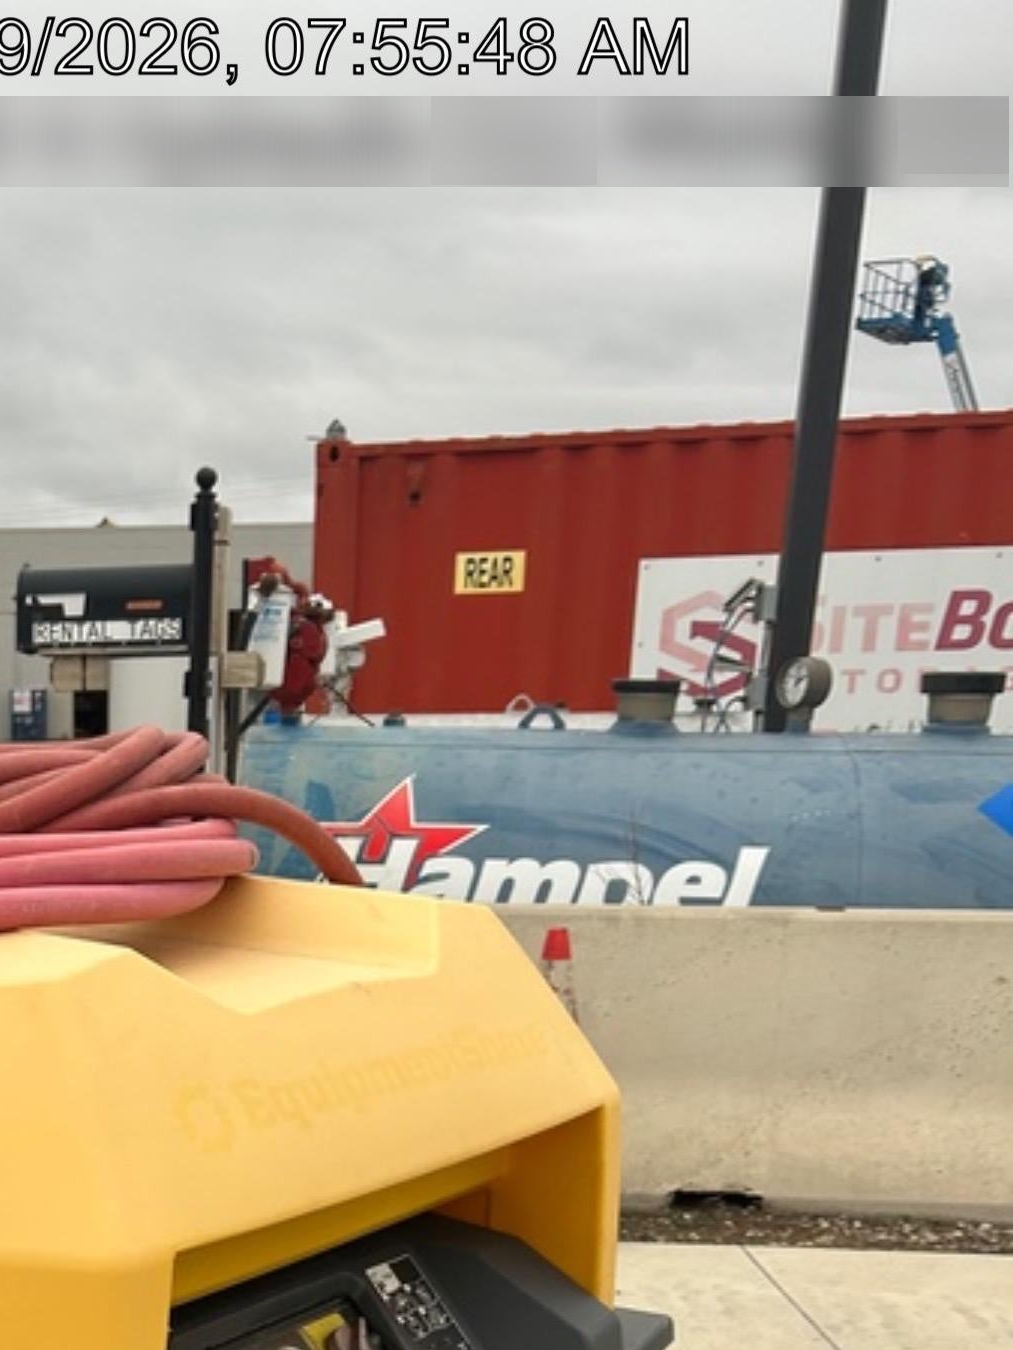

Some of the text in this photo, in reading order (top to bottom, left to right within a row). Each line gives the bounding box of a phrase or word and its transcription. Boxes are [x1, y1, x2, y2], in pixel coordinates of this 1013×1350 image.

[464, 556, 514, 589] REAR
[32, 617, 183, 644] RENTAL TAGS
